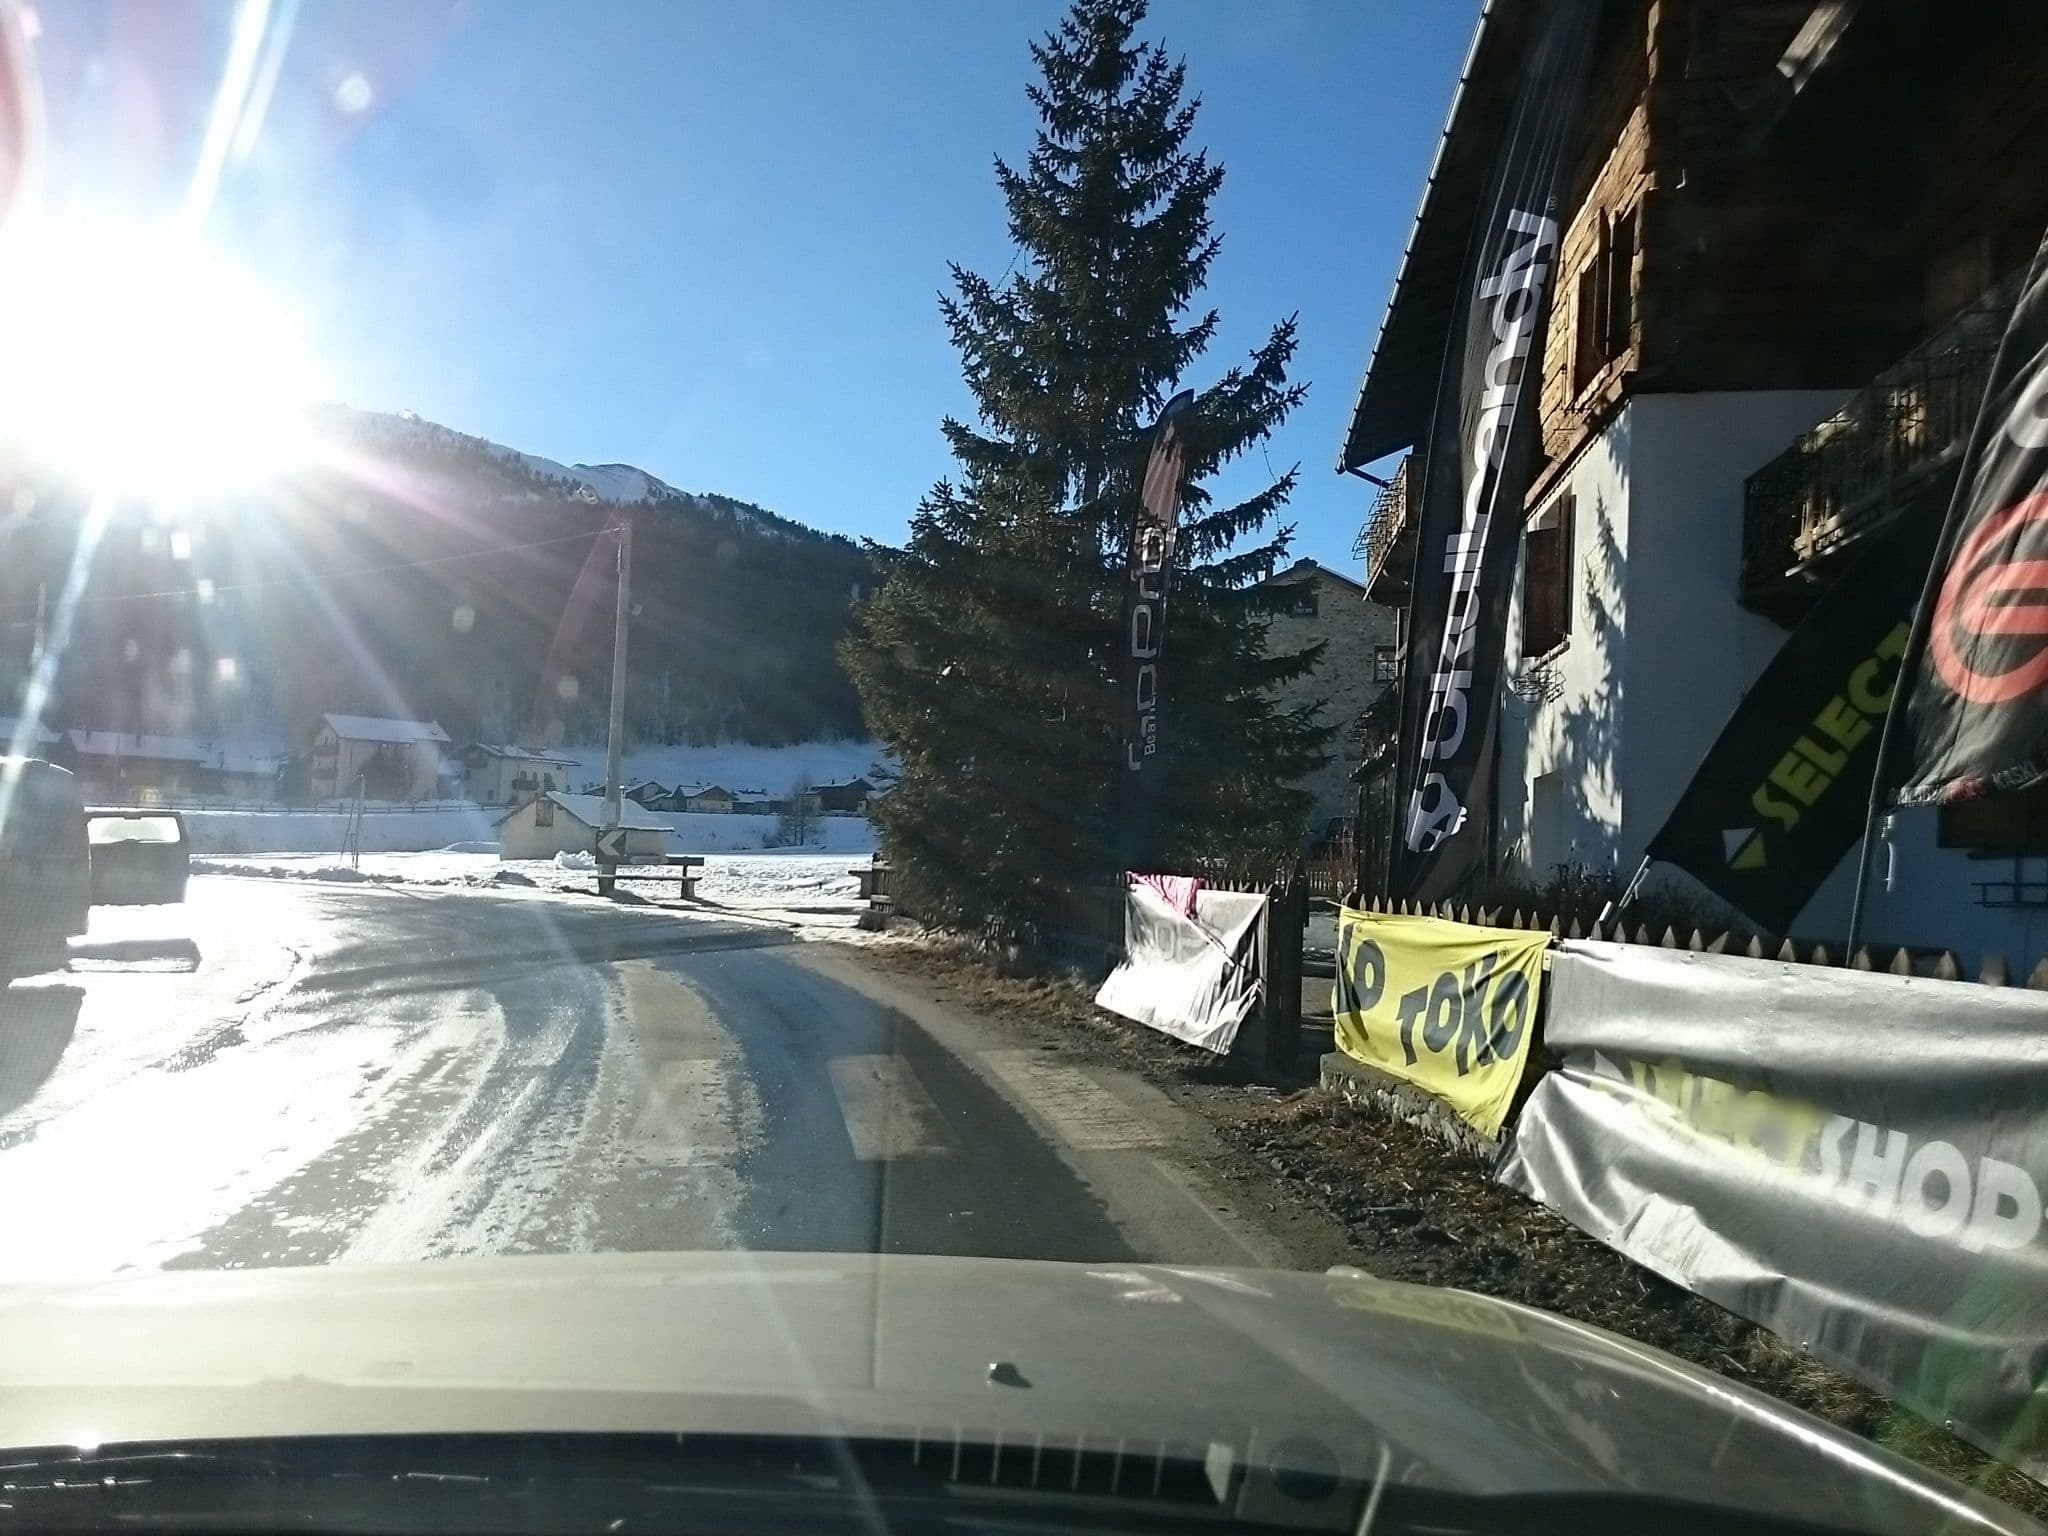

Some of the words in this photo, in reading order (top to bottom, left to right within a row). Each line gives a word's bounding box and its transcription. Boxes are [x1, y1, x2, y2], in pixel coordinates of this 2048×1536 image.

[1422, 208, 1557, 762] Skullcandy
[1398, 950, 1530, 1077] TOKO
[1818, 1113, 2040, 1254] SHOP
